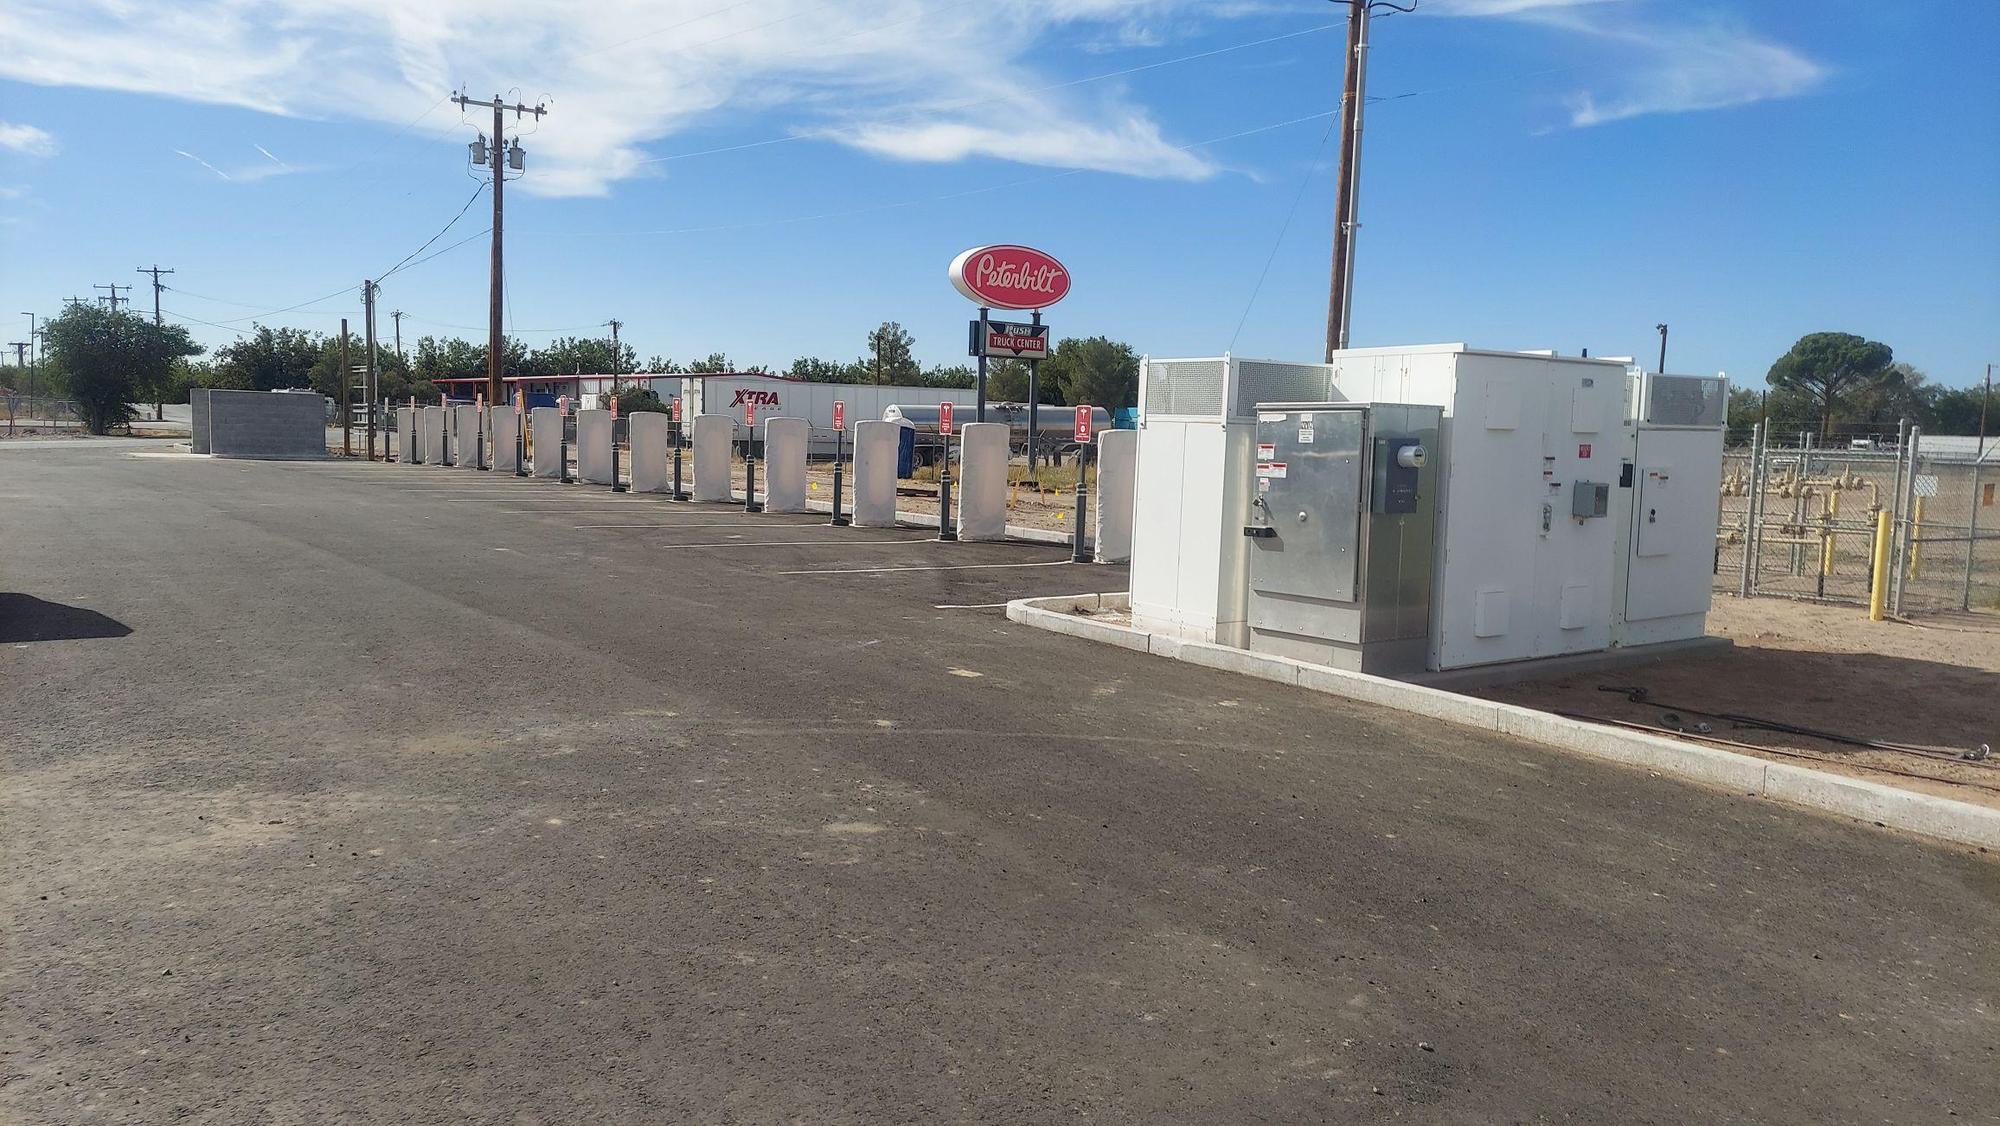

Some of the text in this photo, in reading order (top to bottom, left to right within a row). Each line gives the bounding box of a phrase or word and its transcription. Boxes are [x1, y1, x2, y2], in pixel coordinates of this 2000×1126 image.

[976, 254, 1062, 293] Peterbilt
[993, 337, 1041, 349] TRUCK CENTER
[729, 389, 779, 407] XTRA
